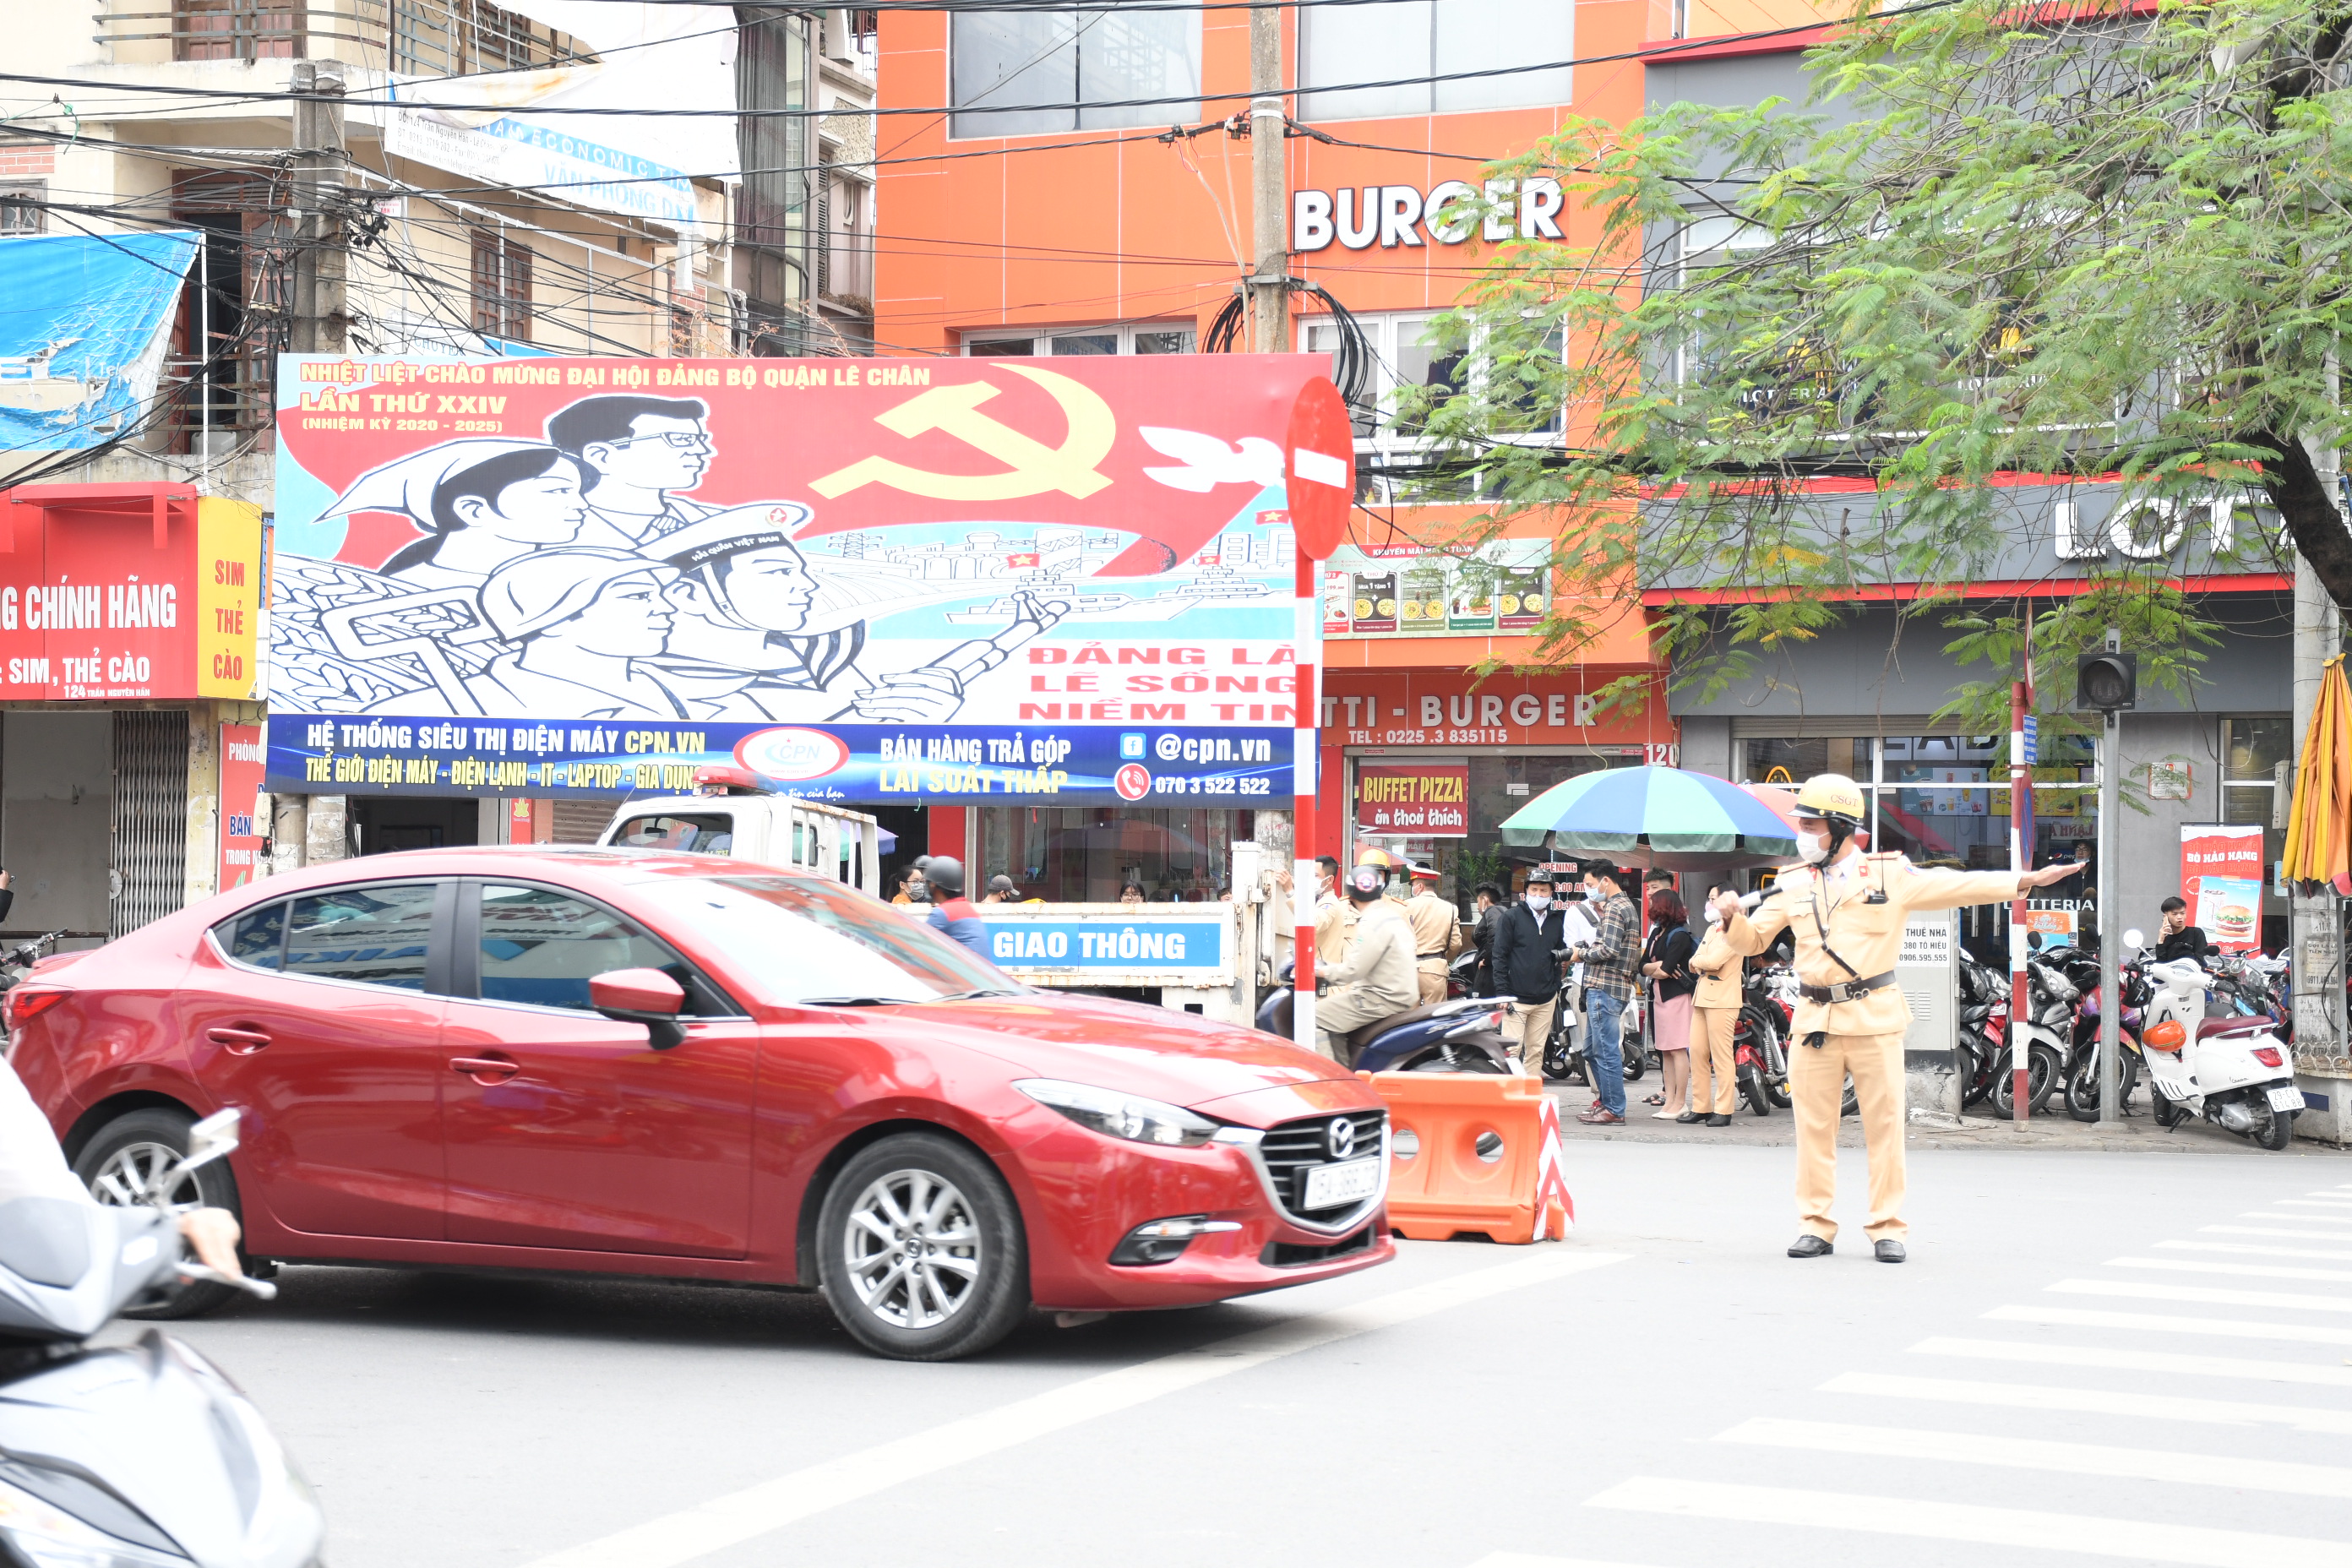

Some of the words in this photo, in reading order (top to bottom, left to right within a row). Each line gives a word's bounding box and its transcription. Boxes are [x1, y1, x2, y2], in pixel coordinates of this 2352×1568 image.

[531, 129, 649, 177] ECONOMIC
[1293, 176, 1567, 252] BURGER
[300, 361, 366, 386] NHIỆT
[373, 361, 419, 386] LIỆT
[425, 362, 486, 384] CHÀO
[493, 363, 560, 386] MỪNG
[567, 367, 605, 389] ĐẠI
[612, 365, 650, 389] HỘI
[656, 363, 719, 386] ĐẢNG
[726, 365, 757, 389] BỘ
[764, 365, 827, 390] QUẬN
[834, 365, 860, 386] LÊ
[867, 365, 930, 386] CHÂN
[301, 387, 360, 412] LẦN
[370, 393, 431, 414] THỨ
[436, 395, 507, 415] XXIV
[302, 416, 365, 432] (NHIỆM
[369, 416, 392, 431] KỲ
[396, 419, 438, 431] 2020
[455, 420, 503, 433] 2025)
[691, 549, 709, 562] HẢI
[709, 542, 733, 555] QUÂN
[734, 537, 755, 547] VIỆT
[758, 536, 780, 544] NAM
[215, 559, 245, 586] SIM
[0, 586, 18, 629] G
[25, 575, 101, 629] CHÍNH
[108, 574, 177, 628] HÃNG
[215, 599, 244, 635] THẺ
[63, 647, 101, 683] THẺ
[108, 651, 150, 683] CÀO
[213, 649, 243, 681] CÀO
[1026, 641, 1206, 665] ĐẢNG
[1232, 644, 1295, 665] LÀ
[63, 685, 86, 698] 124
[1031, 671, 1099, 692] LẼ
[1125, 669, 1295, 693] SỐNG
[1019, 696, 1185, 720] NIỀM
[1392, 707, 1405, 716] -
[1421, 693, 1597, 728] BURGER
[308, 720, 335, 751] HỆ
[340, 718, 411, 749] THỐNG
[418, 721, 467, 750] SIÊU
[473, 727, 507, 756] THỊ
[513, 723, 564, 756] ĐIỆN
[570, 725, 619, 754] MÁY
[624, 731, 705, 754] CPN.VN
[879, 733, 923, 762] BÁN
[928, 733, 982, 763] HÀNG
[988, 732, 1025, 763] TRẢ
[1031, 733, 1071, 764] GÓP
[1155, 733, 1271, 764] @cpn.vn
[1349, 730, 1373, 744] TEL
[1386, 730, 1425, 744] 0225
[1449, 729, 1508, 743] 835115
[780, 744, 820, 760] CPN
[1646, 743, 1680, 766] 120
[306, 750, 334, 782] THẾ
[335, 754, 365, 782] GIỚI
[368, 754, 406, 789] ĐIỆN
[406, 754, 439, 785] MÁY
[451, 755, 486, 791] ĐIỆN
[489, 761, 527, 792] LẠNH
[541, 763, 555, 787] IT
[567, 763, 623, 789] LAPTOP
[635, 765, 660, 789] GIA
[879, 763, 920, 793] LÃI
[928, 762, 995, 794] SUẤT
[1002, 762, 1069, 794] THẤP
[1156, 777, 1185, 794] 070
[1190, 777, 1201, 794] 3
[1205, 777, 1235, 794] 522
[1243, 777, 1271, 795] 522
[1363, 776, 1418, 803] BUFFET
[1419, 776, 1463, 803] PIZZA
[1831, 794, 1859, 807] CSGT
[230, 811, 252, 836] BÁN
[1375, 810, 1390, 825] ăn
[1393, 806, 1424, 827] thoả
[1429, 807, 1462, 827] thích
[226, 850, 251, 865] TRONG
[2186, 852, 2201, 863] BÒ
[2203, 851, 2225, 863] HẢO
[2228, 851, 2258, 863] HẠNG
[2004, 898, 2094, 911] LTTERIA
[994, 931, 1068, 959] GIAO
[1078, 927, 1185, 960] THÔNG
[1906, 928, 1927, 937] THUÊ
[1899, 954, 1947, 962] 0906.595.555
